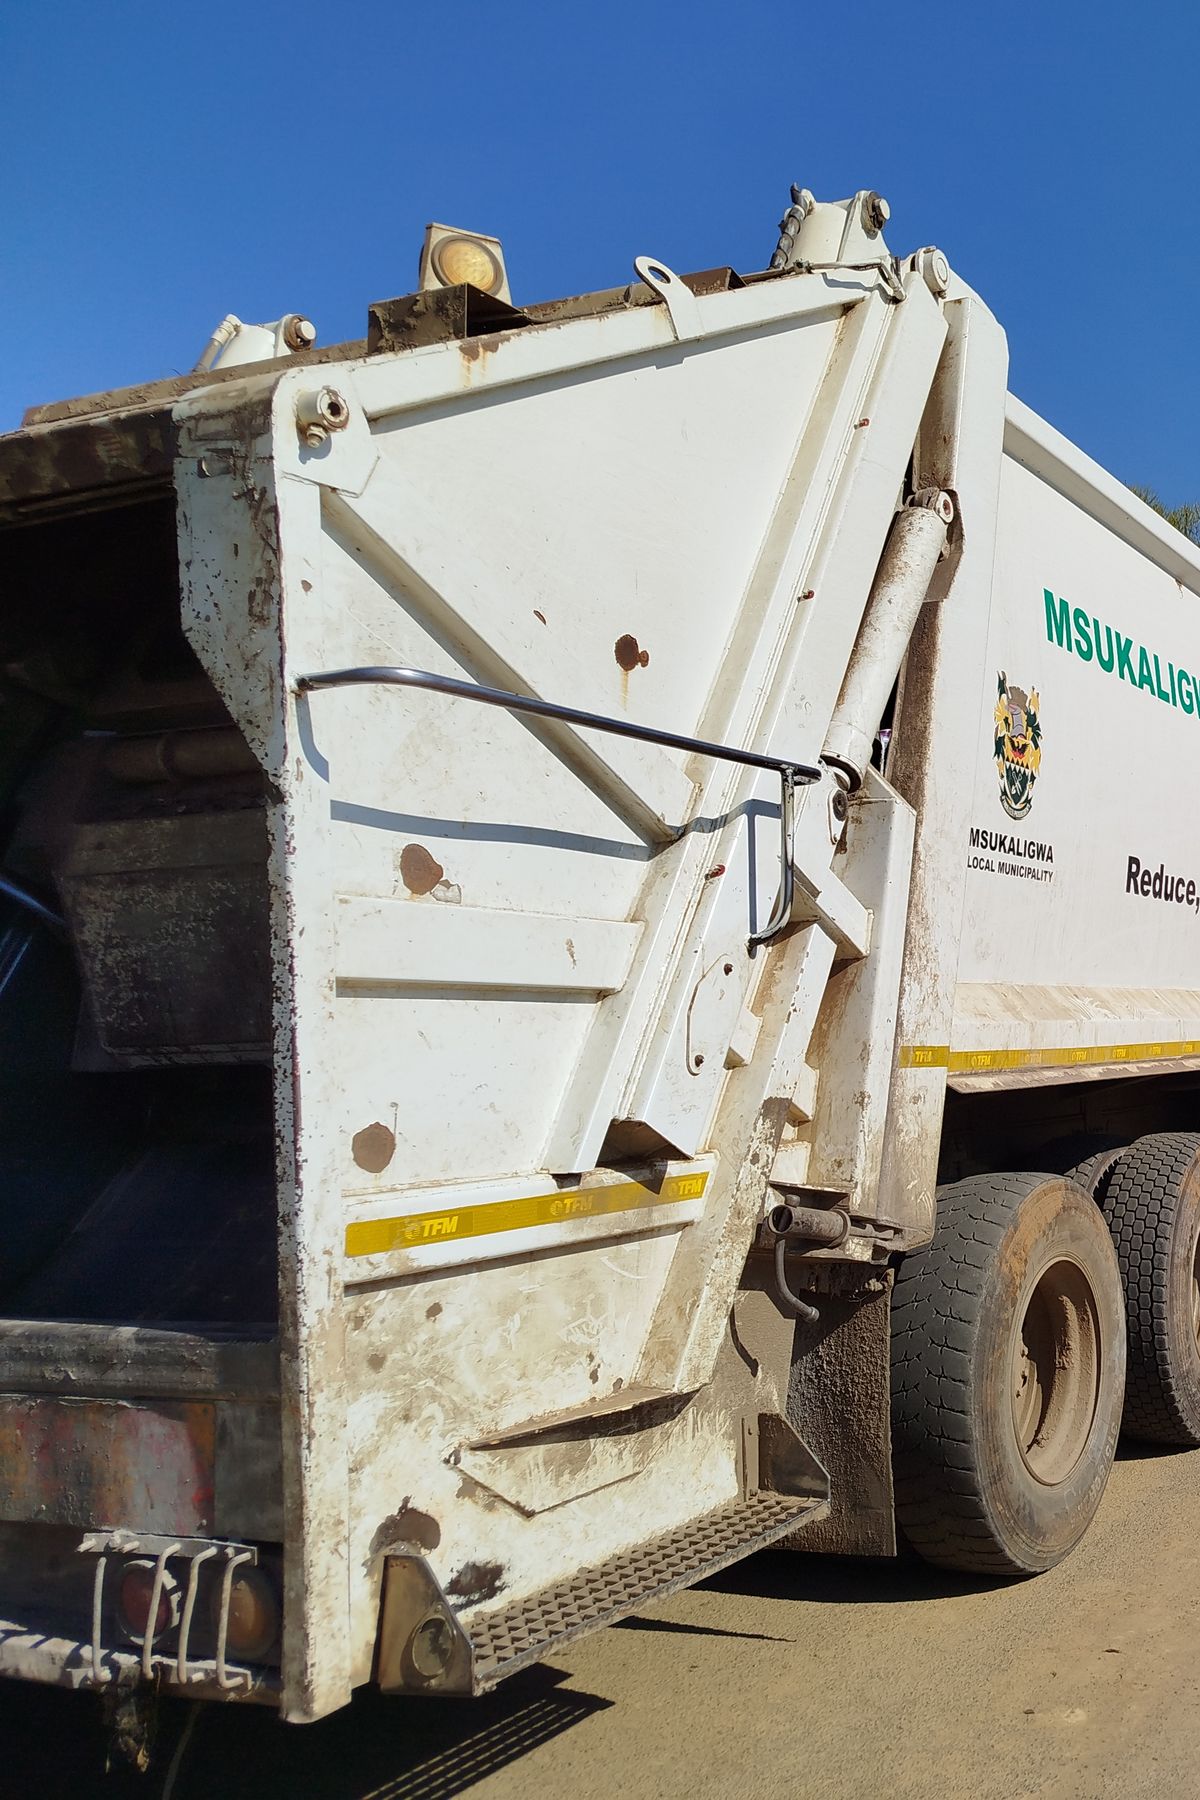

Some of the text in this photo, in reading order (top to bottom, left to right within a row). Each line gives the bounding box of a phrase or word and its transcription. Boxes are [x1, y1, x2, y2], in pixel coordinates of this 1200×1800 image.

[969, 827, 1054, 863] MSUKALIGWA
[967, 855, 1054, 883] LOCAL MUNICIPALITY
[1125, 855, 1200, 915] Reduce,
[678, 1178, 703, 1195] TFM
[423, 1215, 459, 1238] TFM
